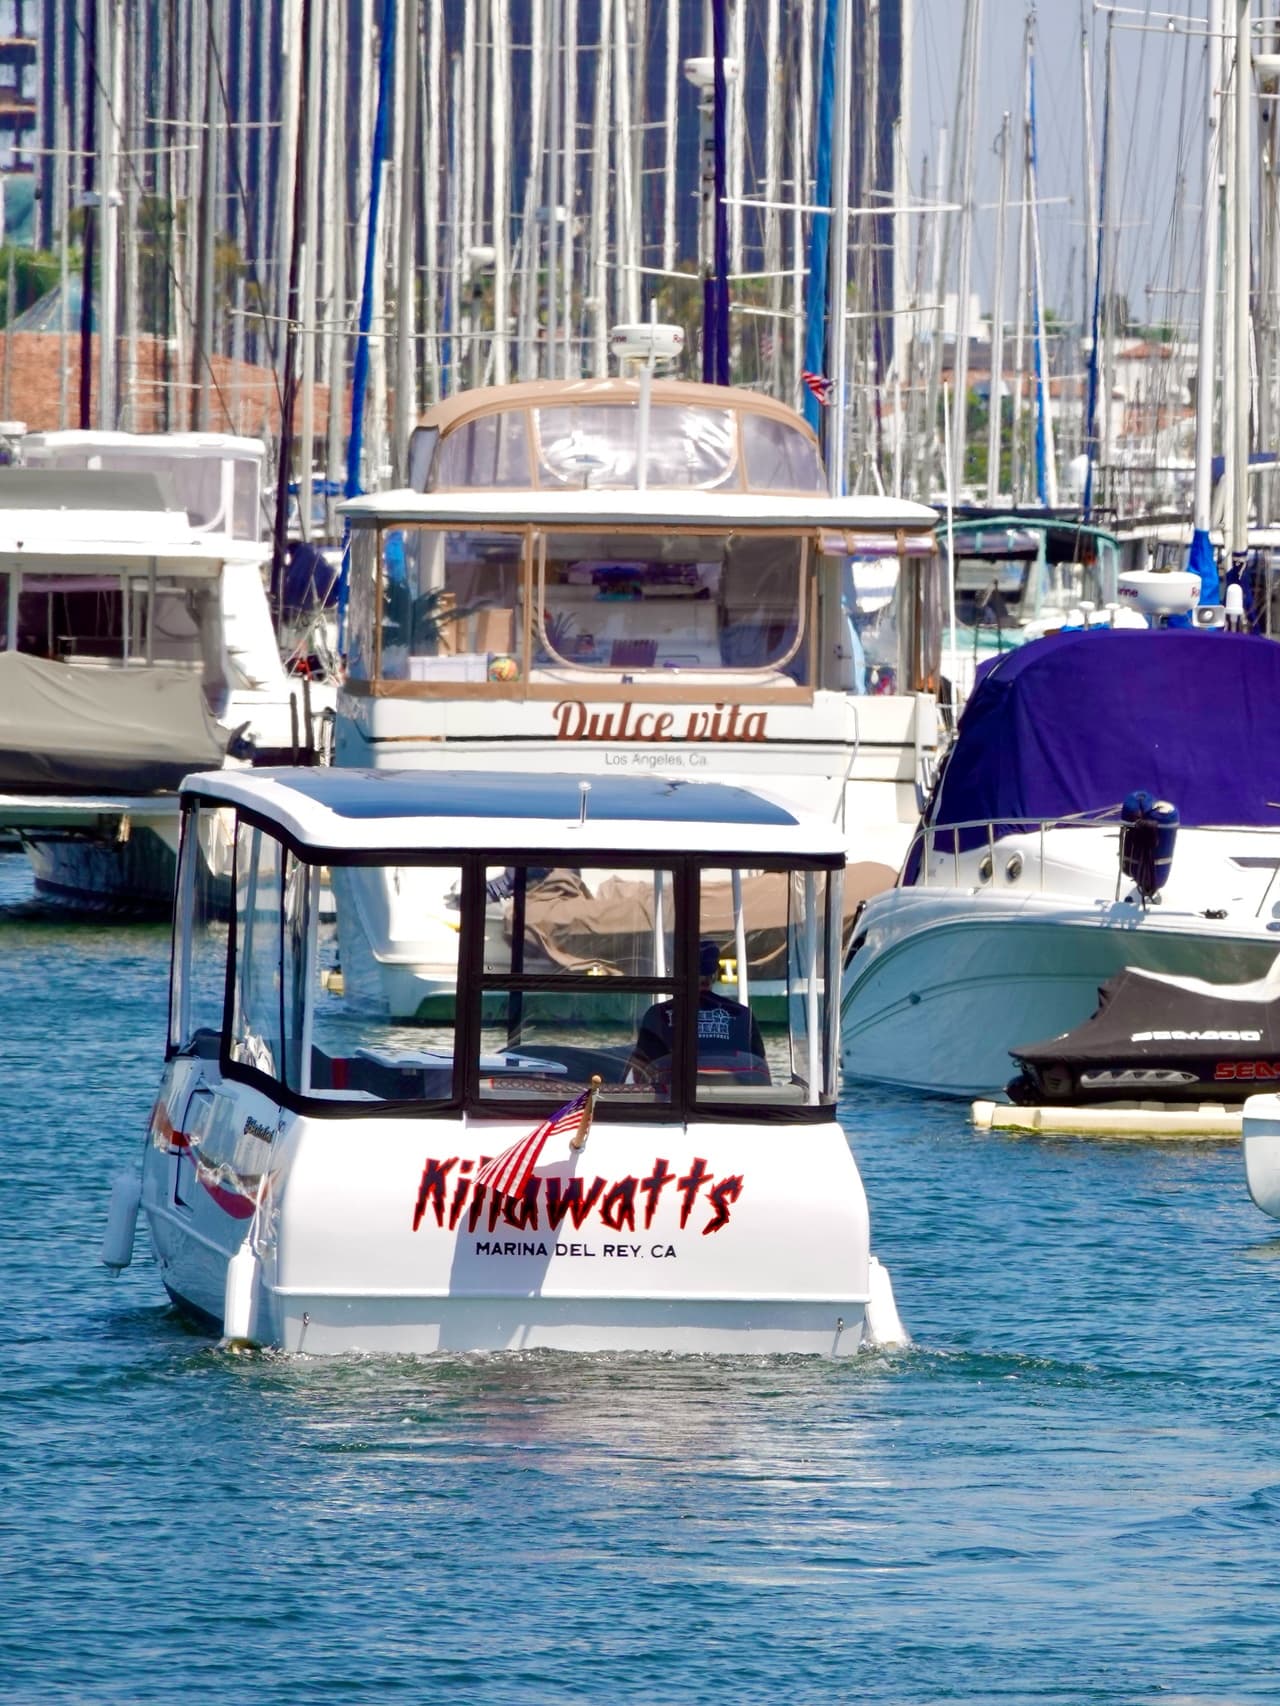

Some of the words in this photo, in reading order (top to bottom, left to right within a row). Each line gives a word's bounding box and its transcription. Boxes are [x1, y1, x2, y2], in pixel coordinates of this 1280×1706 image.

[553, 700, 674, 741] Dulce
[685, 702, 768, 741] vita
[605, 752, 628, 766] Los
[475, 1242, 548, 1257] MARINA
[555, 1243, 596, 1257] DEL
[650, 1245, 677, 1258] CA
